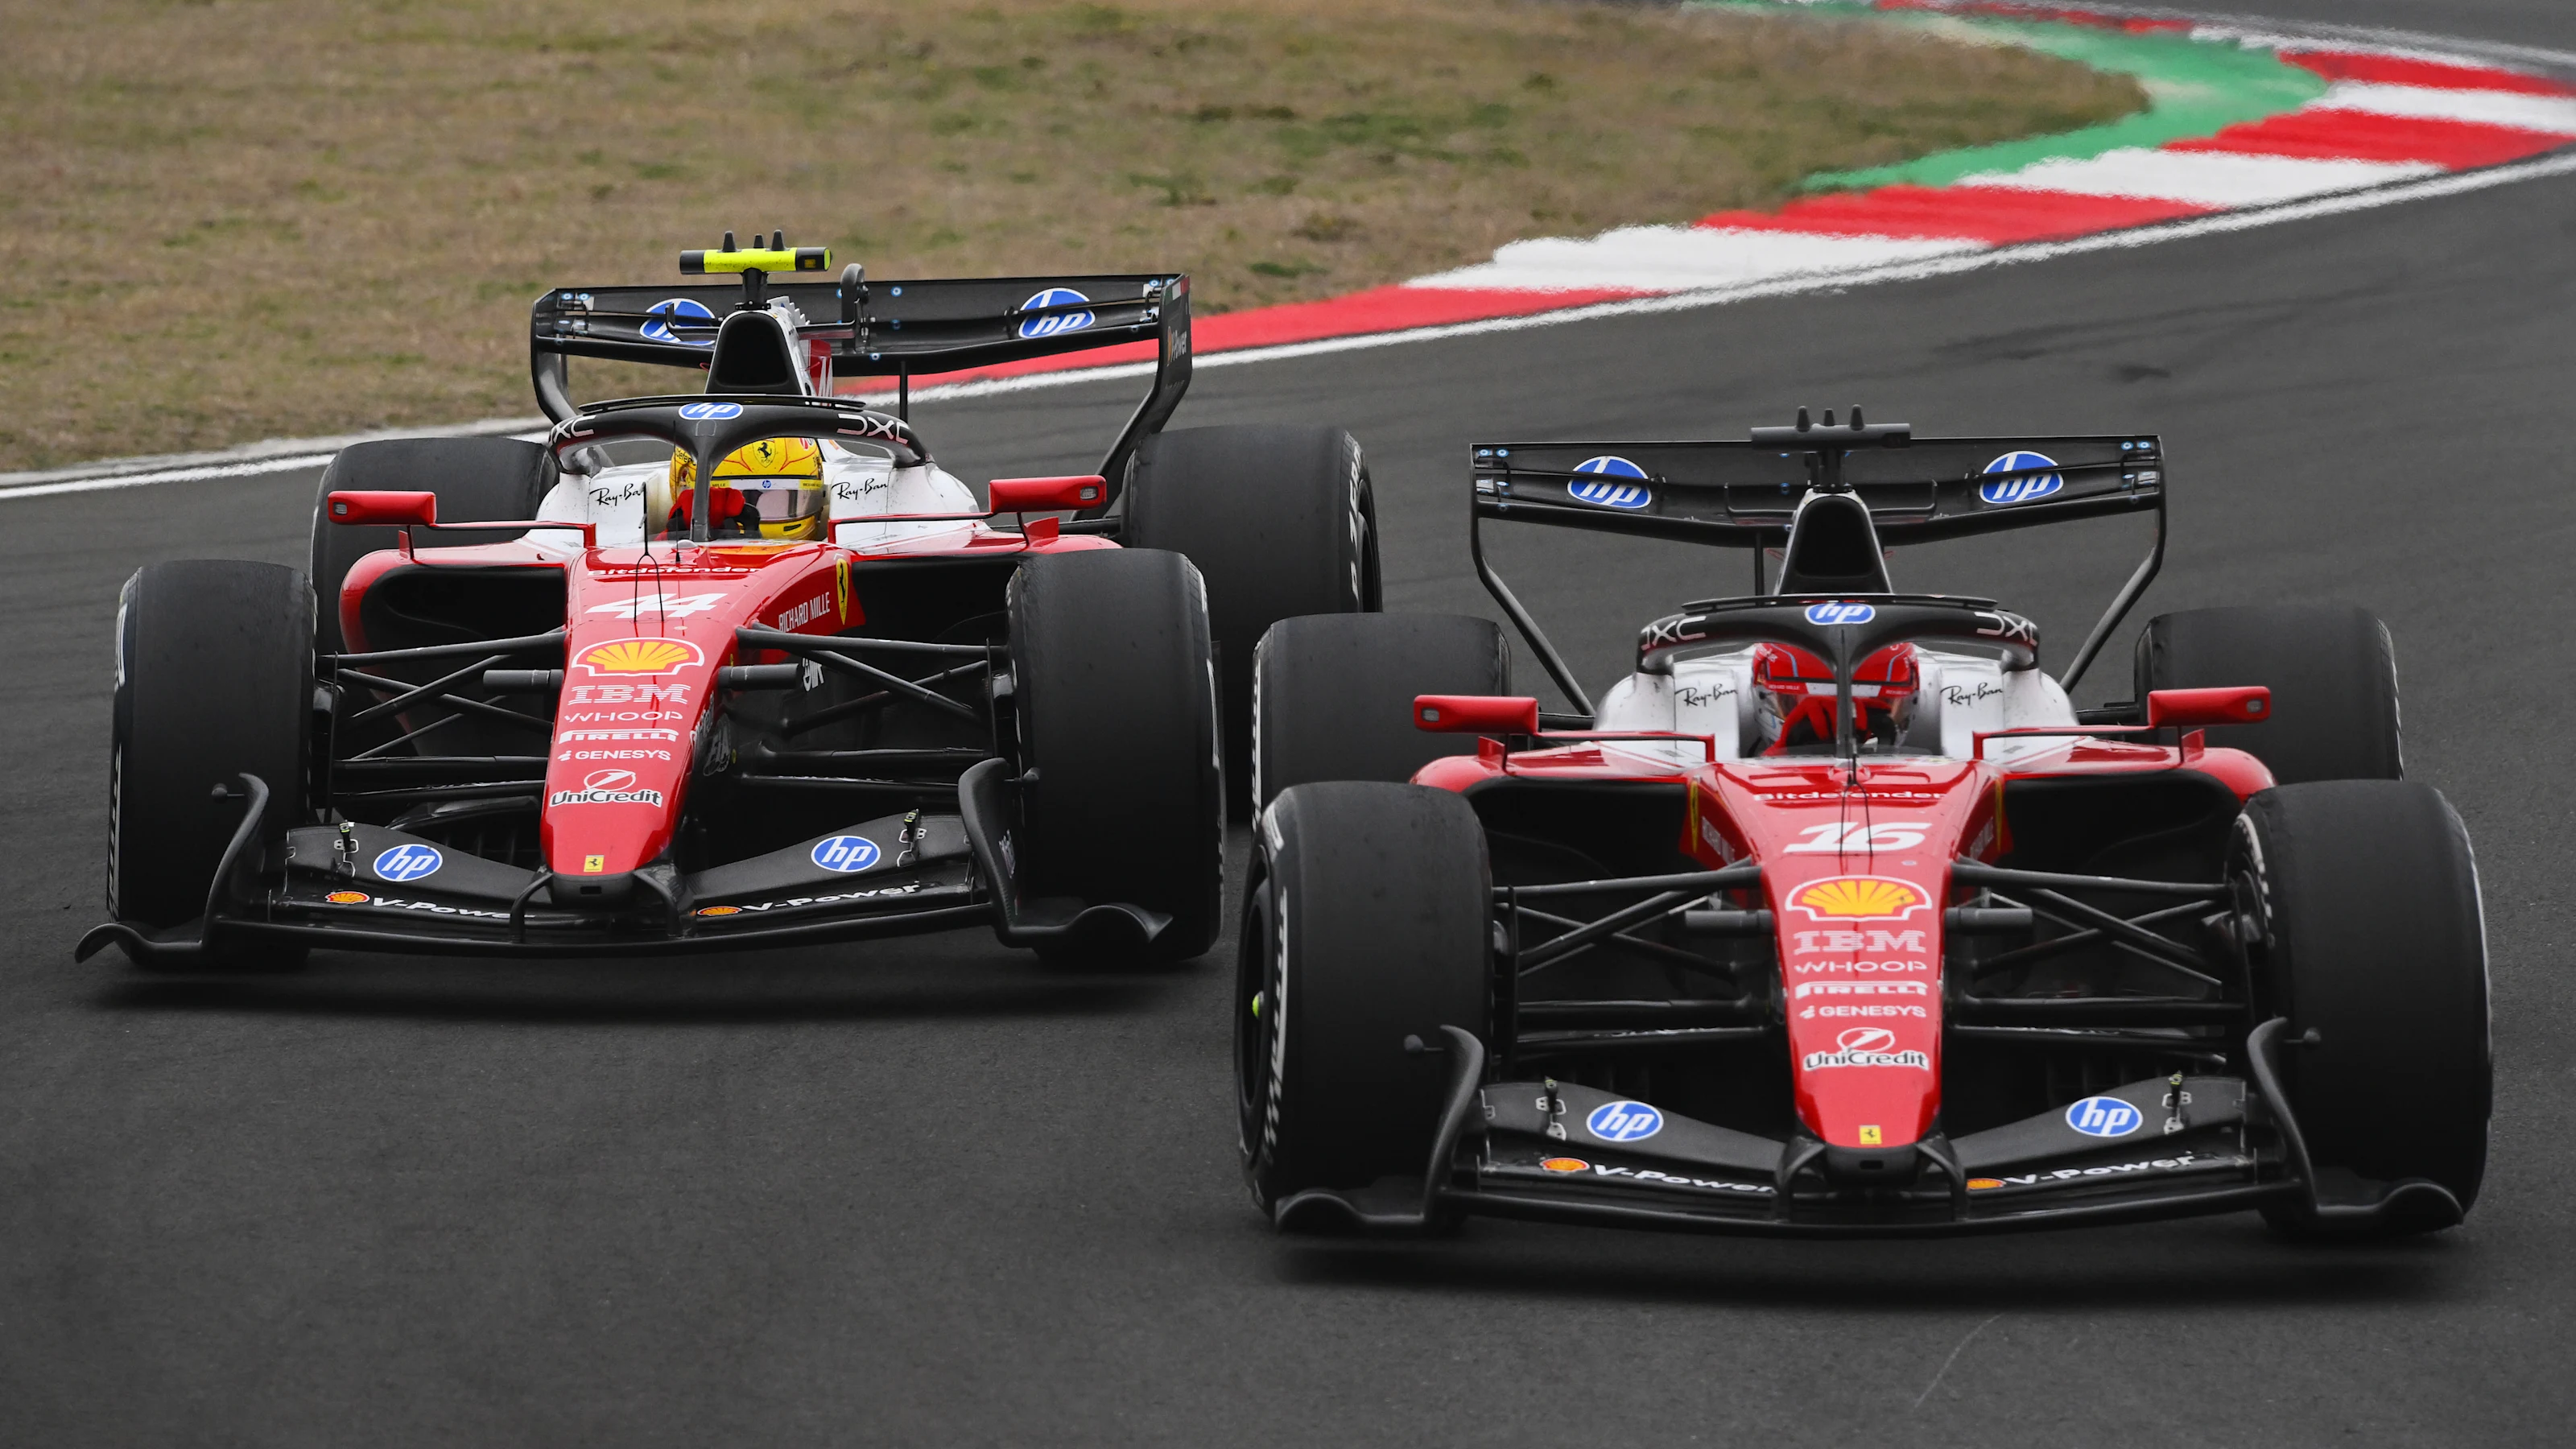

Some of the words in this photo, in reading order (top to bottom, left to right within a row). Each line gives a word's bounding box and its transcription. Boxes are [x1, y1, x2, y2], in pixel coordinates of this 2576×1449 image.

[1029, 288, 1087, 336] hp
[687, 402, 736, 419] hp
[836, 414, 909, 444] DXC
[831, 477, 888, 501] Ray-Ban
[1579, 457, 1640, 506] hp
[1992, 453, 2048, 502] hp
[587, 567, 762, 576] Bitdefender
[584, 593, 728, 619] 44
[778, 602, 808, 633] RICHARD
[809, 592, 830, 620] MILLE
[1815, 604, 1865, 623] hp
[568, 684, 691, 705] IBM
[1674, 683, 1737, 707] Ray-Ban
[1940, 683, 2003, 705] Ray-Ban
[564, 711, 683, 722] WHOOP
[559, 729, 679, 744] PIRELLI
[575, 749, 671, 761] GENESYS
[551, 791, 662, 806] UniCredit
[1782, 822, 1932, 852] 16
[381, 845, 436, 881] hp
[820, 836, 872, 871] hp
[742, 883, 920, 911] V-Power
[1793, 930, 1926, 955] IBM
[1794, 960, 1927, 974] WHOOP
[1795, 981, 1928, 1000] PIRELLI
[1819, 1005, 1926, 1018] GENESYS
[1804, 1051, 1929, 1071] UniCredit
[1597, 1101, 1654, 1141] hp
[2079, 1097, 2132, 1136] hp
[2004, 1154, 2195, 1185] V-Power
